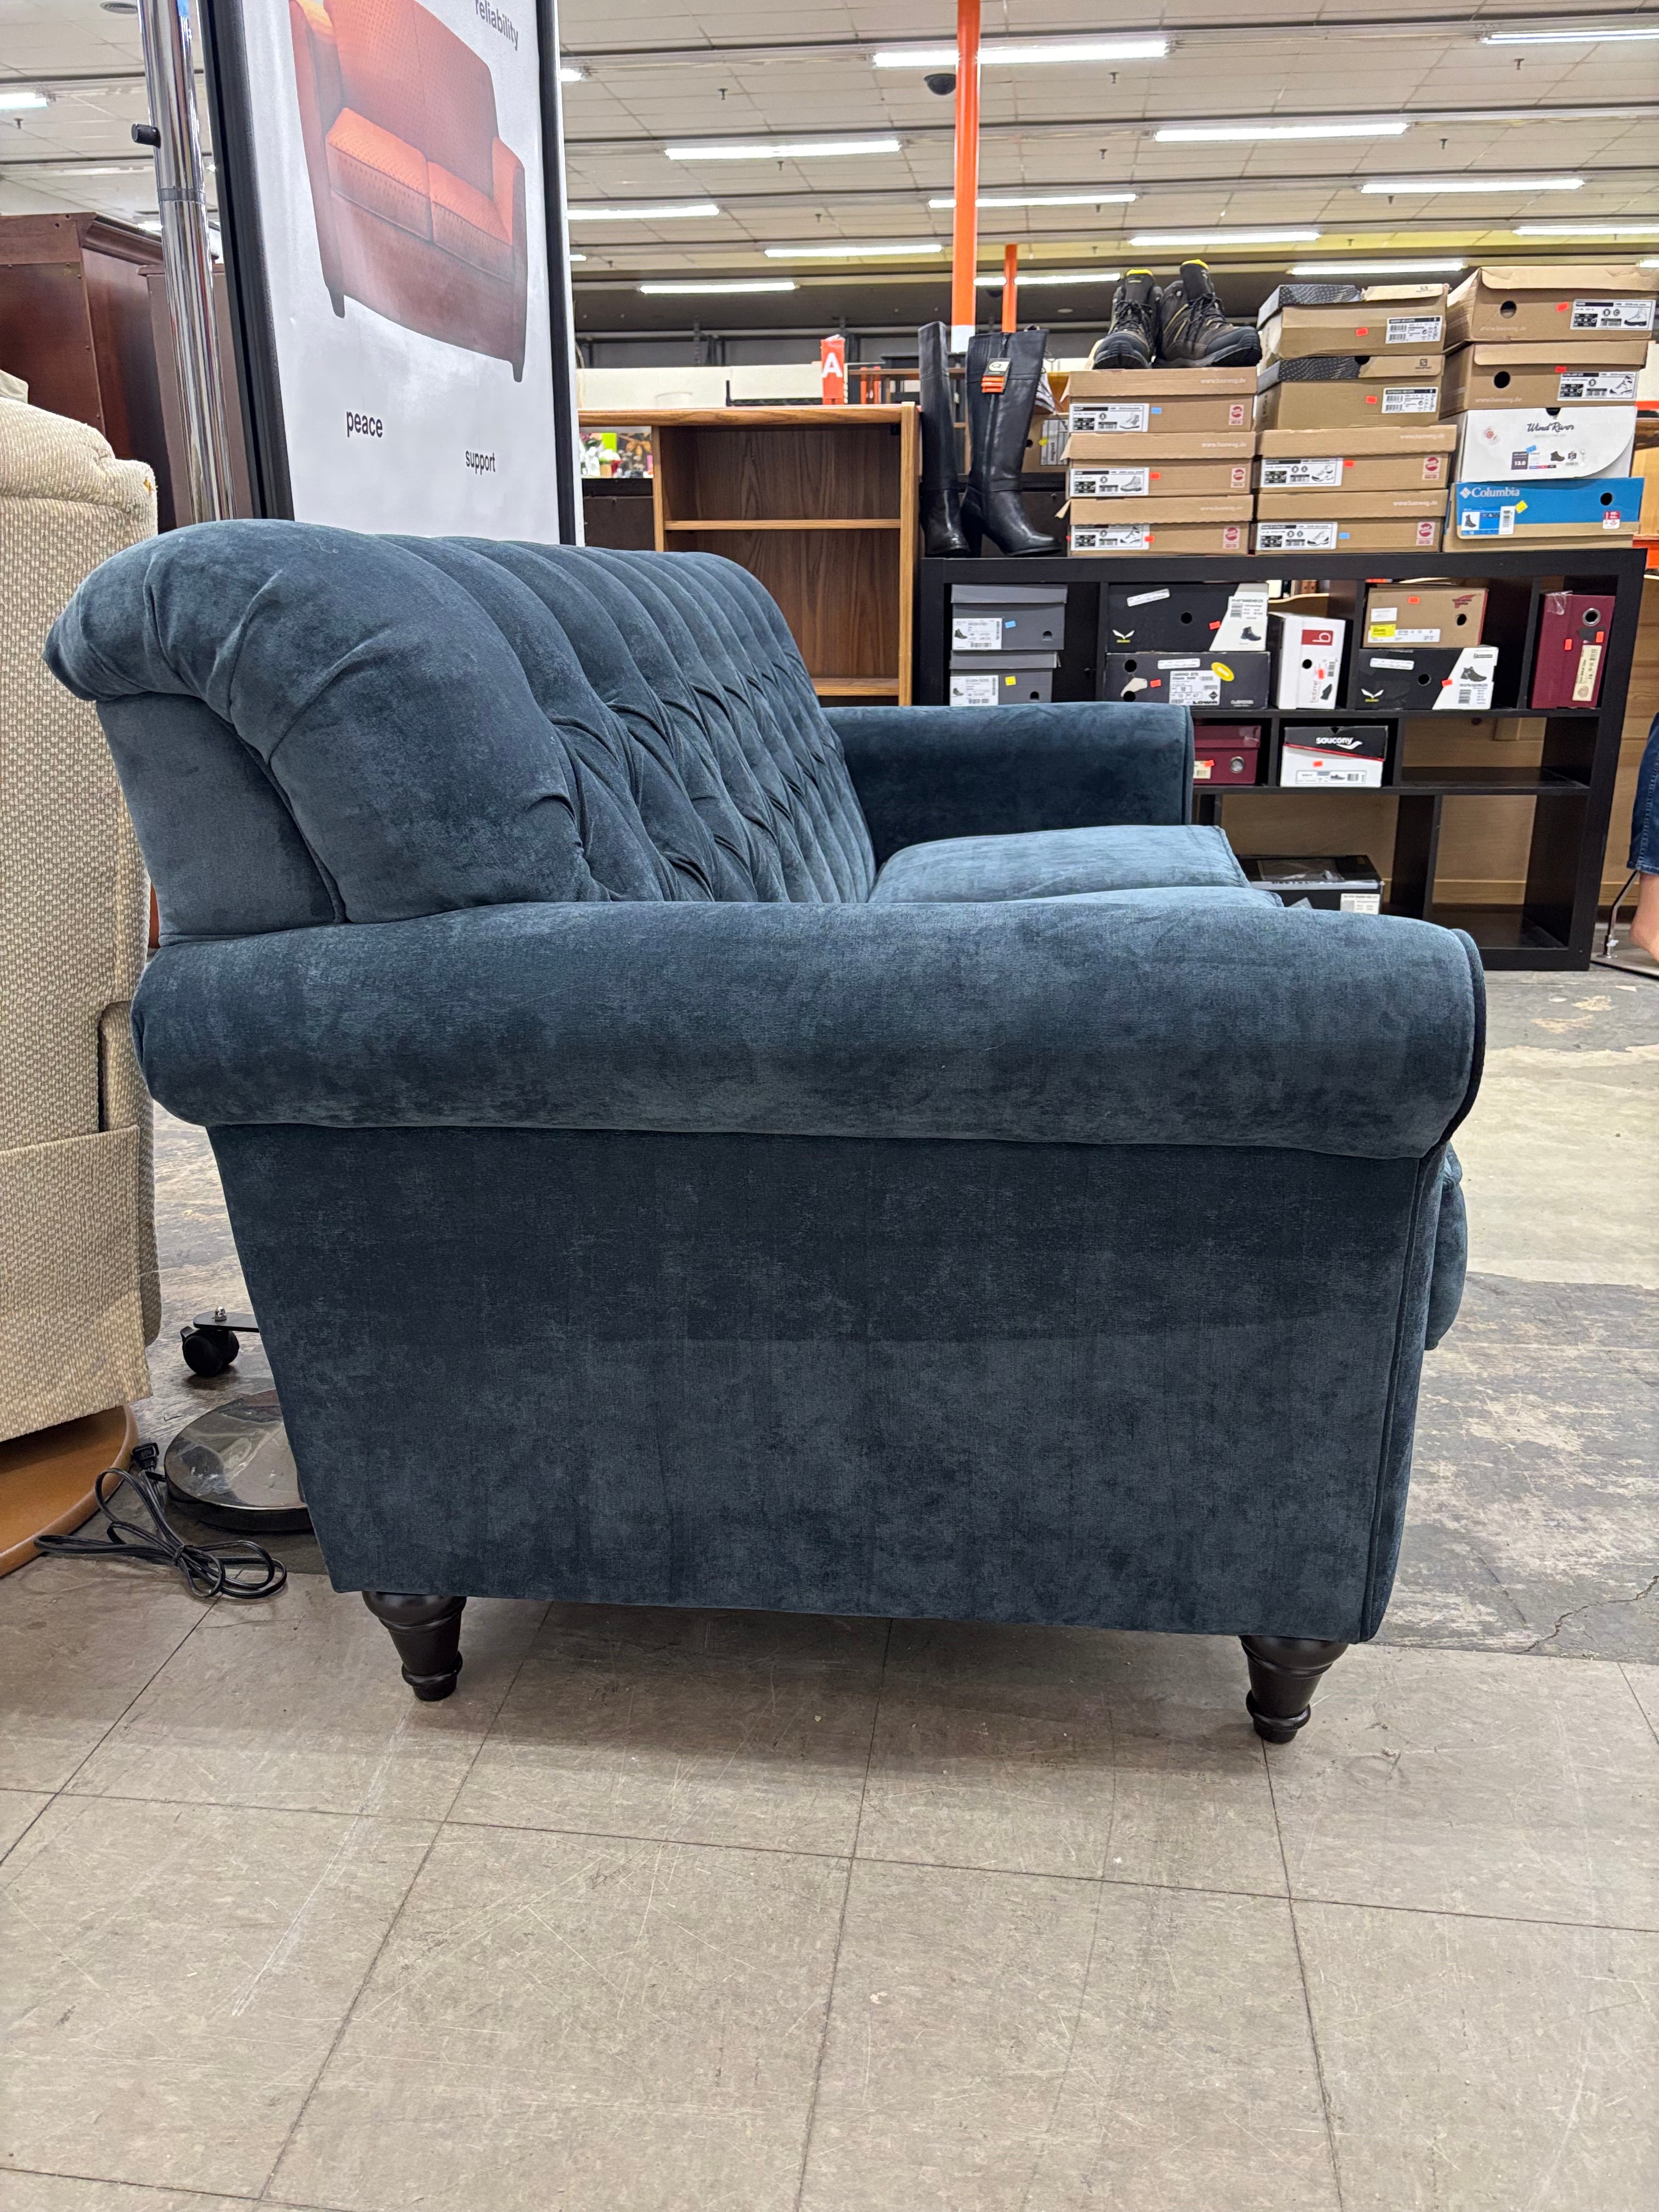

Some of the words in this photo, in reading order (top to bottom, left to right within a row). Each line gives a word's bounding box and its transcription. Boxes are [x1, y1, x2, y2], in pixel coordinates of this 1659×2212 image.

[475, 0, 518, 51] reliability
[822, 352, 843, 377] A
[346, 411, 383, 438] peace
[1527, 422, 1551, 432] Wind
[1551, 422, 1575, 432] River
[465, 450, 495, 475] support
[1471, 486, 1520, 498] Columbia
[1316, 737, 1354, 745] saucony
